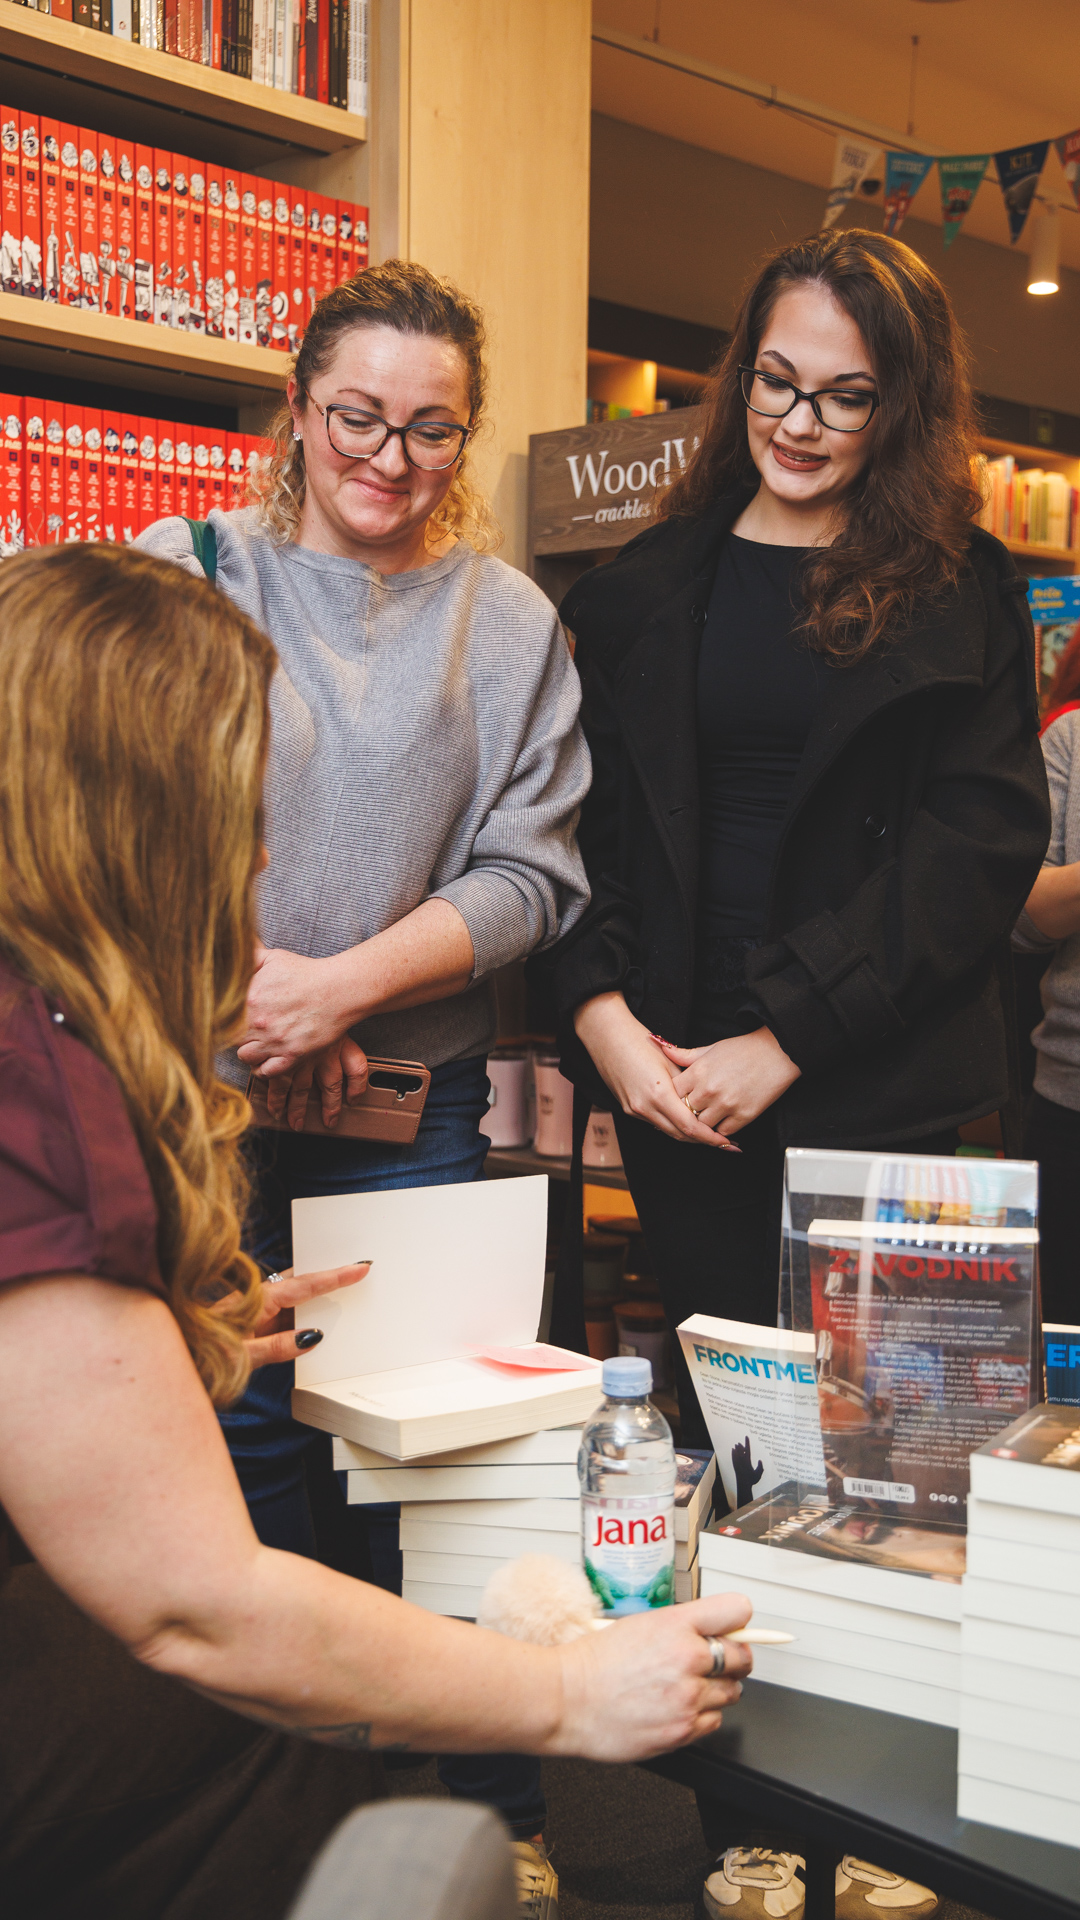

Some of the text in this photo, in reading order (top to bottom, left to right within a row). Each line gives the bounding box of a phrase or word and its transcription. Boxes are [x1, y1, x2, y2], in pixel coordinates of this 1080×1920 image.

[828, 1249, 1018, 1283] ZAVODNIK
[693, 1343, 817, 1385] FRONTME
[592, 1515, 668, 1547] Jana
